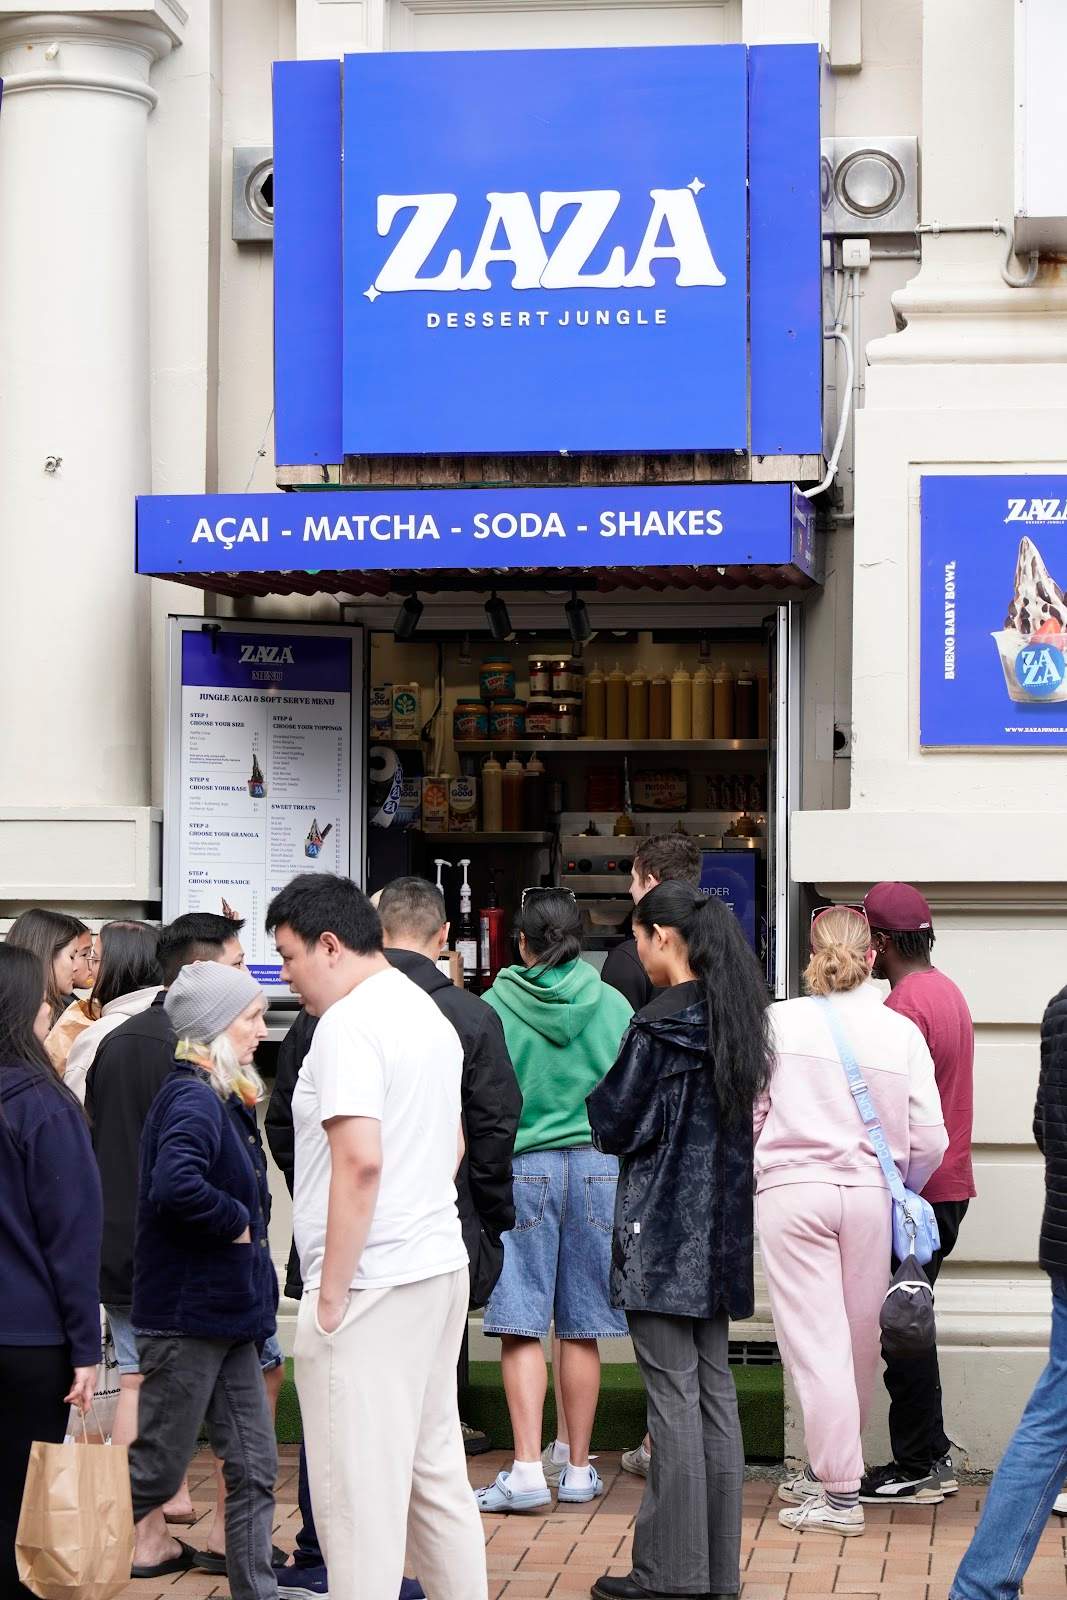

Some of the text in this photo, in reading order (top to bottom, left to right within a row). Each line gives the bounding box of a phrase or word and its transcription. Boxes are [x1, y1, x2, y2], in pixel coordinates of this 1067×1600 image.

[373, 188, 727, 293] ZAZA
[426, 309, 667, 328] DESSERT JUNGLE
[191, 517, 269, 550] AÇAI
[303, 514, 441, 542] MATCHA
[473, 512, 567, 539] SODA
[599, 509, 723, 537] SHAKES
[944, 560, 956, 680] BUENO BABY BOWL
[240, 645, 295, 664] ZAZA
[252, 671, 283, 681] MENU
[199, 693, 230, 701] JUNGLE
[260, 696, 282, 704] SOFT
[283, 697, 310, 705] SERVE
[311, 698, 336, 706] MENU
[452, 788, 473, 797] Good
